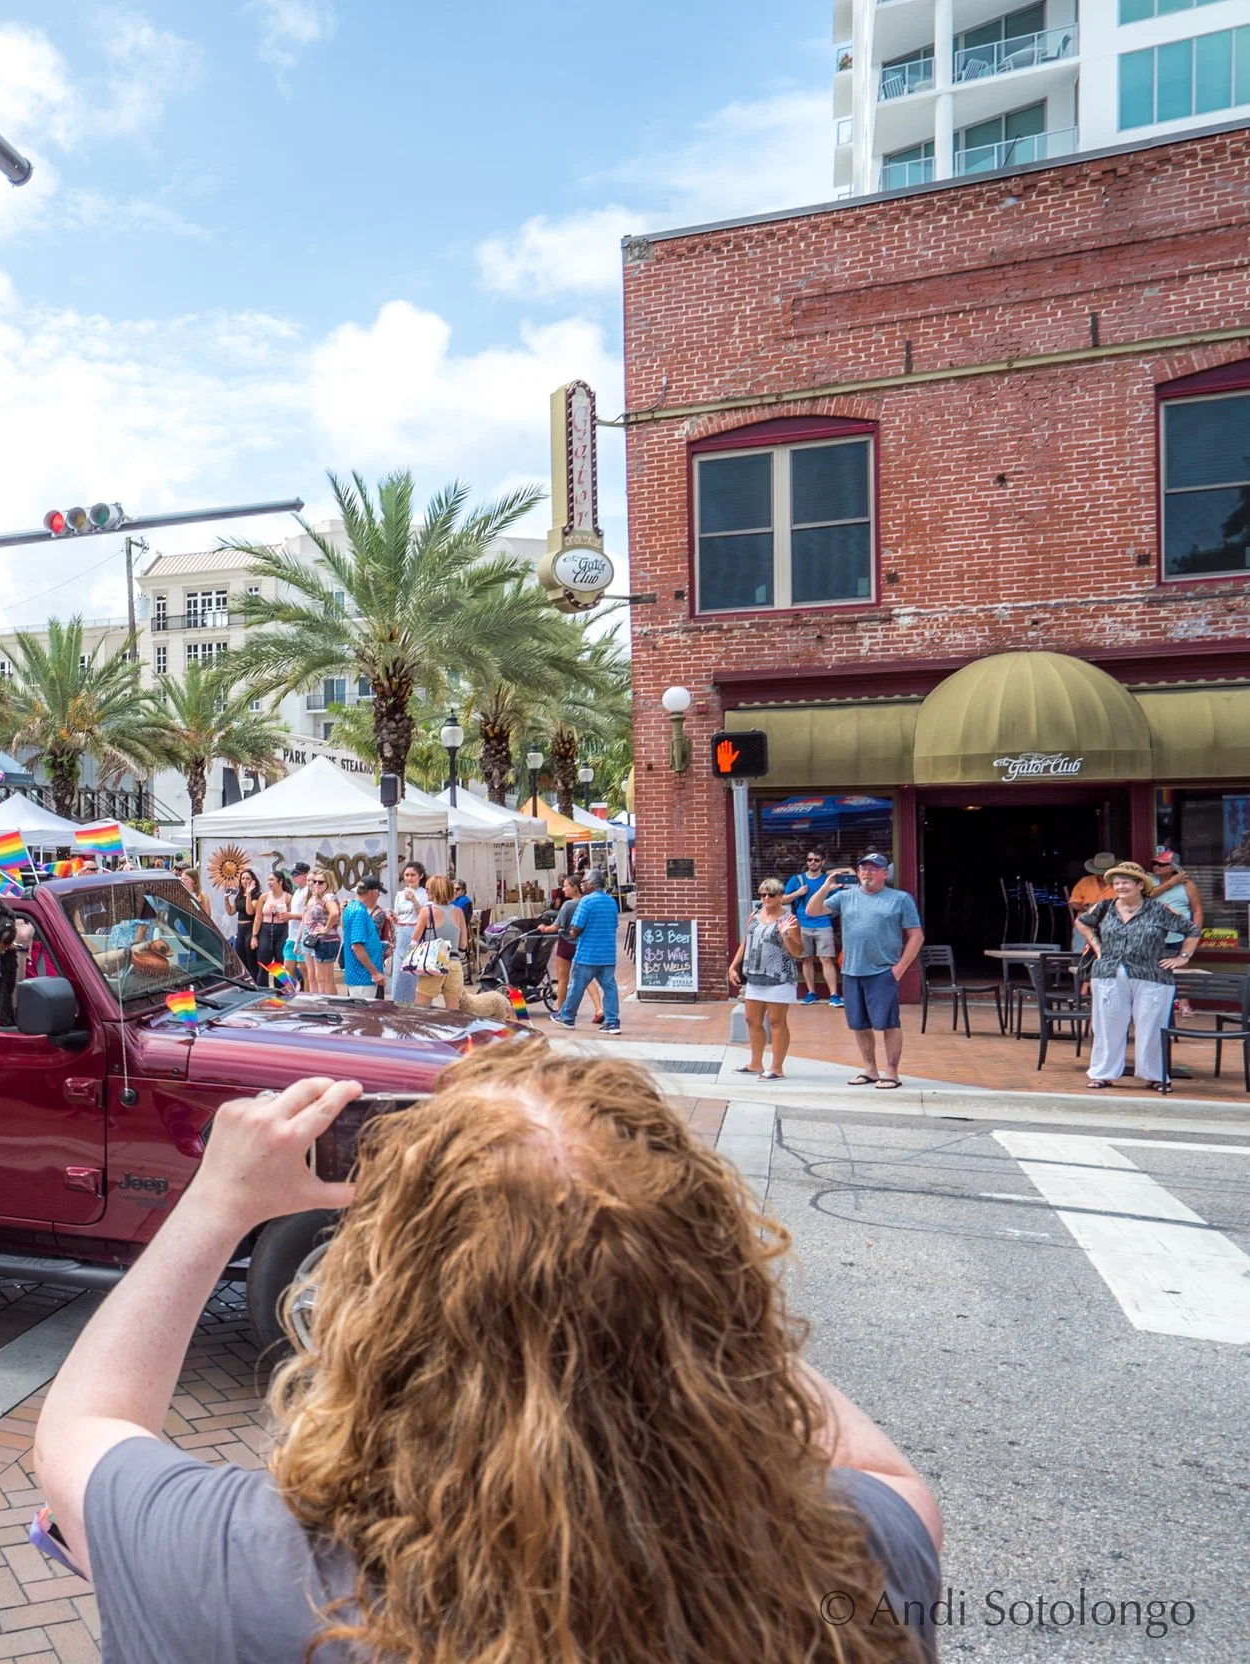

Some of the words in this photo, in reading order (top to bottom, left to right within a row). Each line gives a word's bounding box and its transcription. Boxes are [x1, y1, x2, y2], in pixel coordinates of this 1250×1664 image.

[574, 405, 591, 527] Gator
[579, 557, 606, 572] Gator
[573, 569, 601, 584] Club
[283, 748, 307, 765] PARK
[1002, 758, 1048, 781] Gator
[1050, 757, 1083, 774] Club
[643, 929, 664, 944] $3
[667, 929, 692, 944] Beer
[644, 947, 664, 961] $5
[642, 961, 661, 975] $5
[117, 1171, 169, 1195] Jeep
